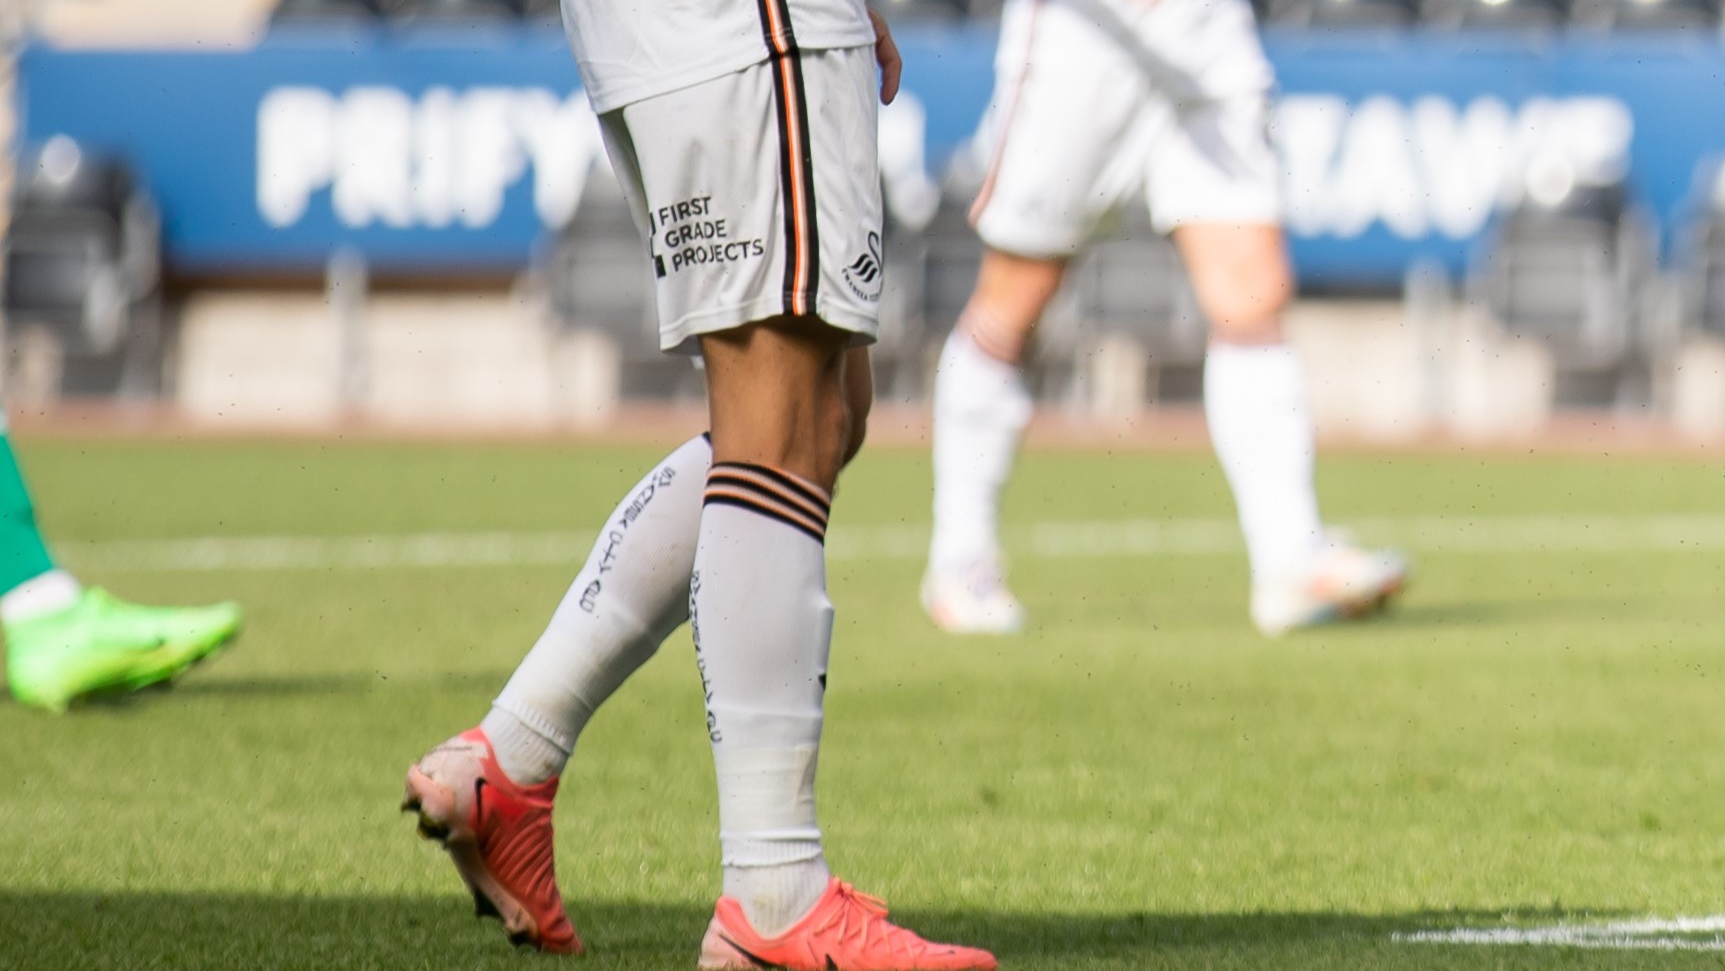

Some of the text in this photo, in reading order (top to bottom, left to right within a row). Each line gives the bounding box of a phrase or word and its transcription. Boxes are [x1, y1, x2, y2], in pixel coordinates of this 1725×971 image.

[658, 196, 711, 226] FIRST
[664, 219, 727, 248] GRADE
[672, 238, 764, 272] PROJECTS
